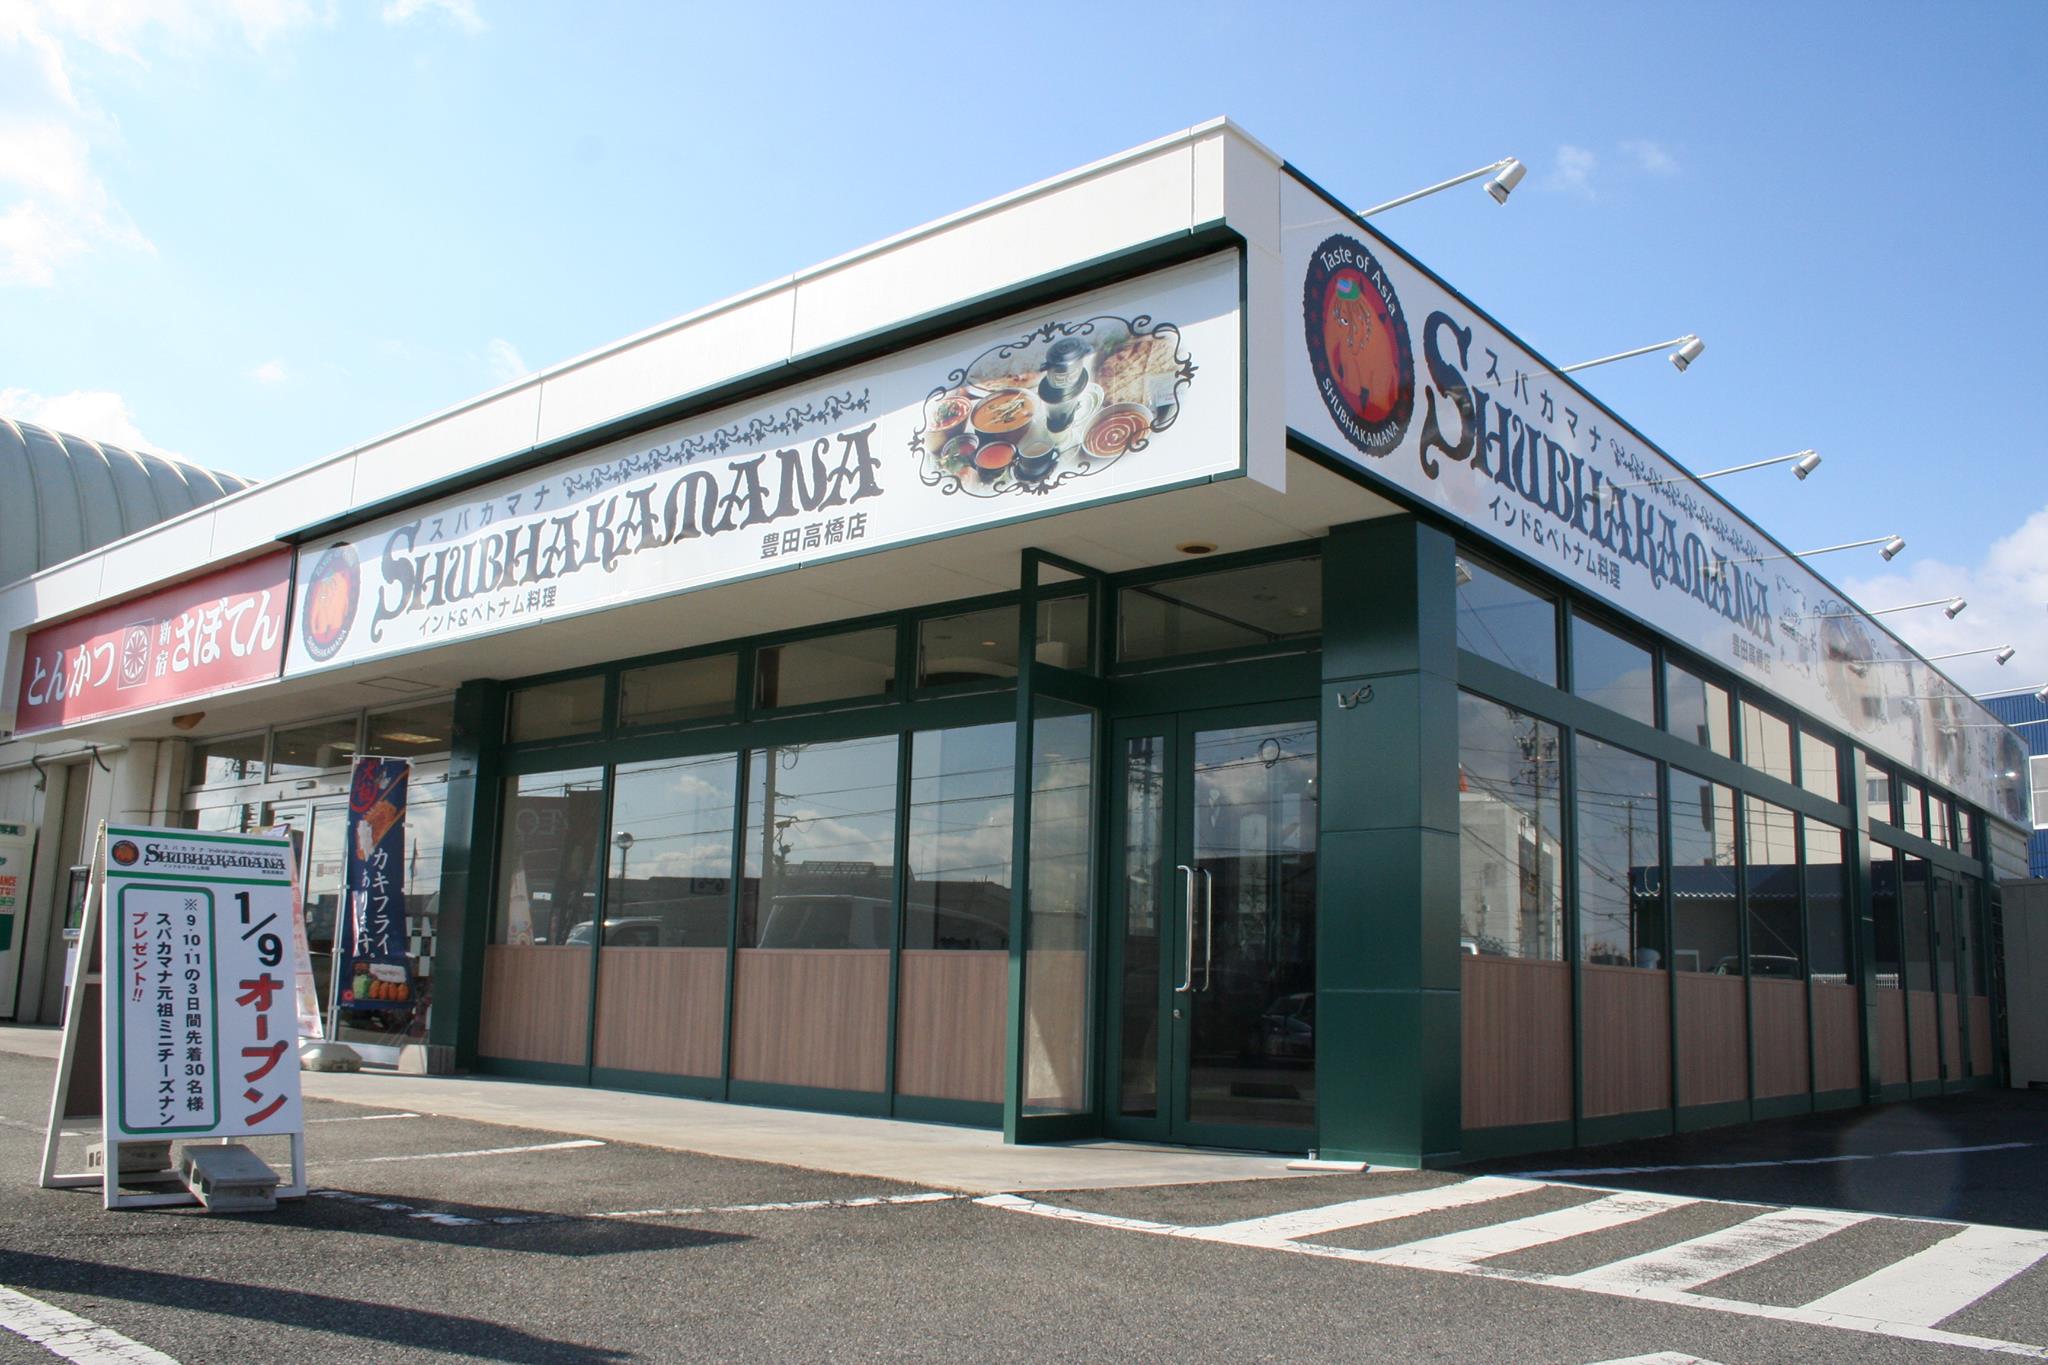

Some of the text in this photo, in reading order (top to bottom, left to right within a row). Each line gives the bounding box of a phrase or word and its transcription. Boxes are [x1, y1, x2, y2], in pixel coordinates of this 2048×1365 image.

[1320, 244, 1397, 318] Taste of Asia
[1322, 377, 1399, 448] SHUBHAKAMANA
[1485, 347, 1602, 453] スバカマナ
[429, 484, 550, 542] スバカマナ
[1419, 310, 1775, 648] SHUBHAKAMANA
[370, 422, 885, 643] SHUBHAKAMANA
[760, 512, 868, 560] 豊田高橋店
[1488, 495, 1621, 591] インド&ベトナム料理
[155, 618, 171, 678] 新宿
[172, 590, 281, 673] さぼてん
[418, 585, 557, 637] インド&ベトナム料理
[27, 641, 115, 706] とんかつ
[144, 843, 287, 870] SHUBHAKAMANA
[234, 891, 284, 967] 1/9
[372, 847, 391, 956] カキフライ
[235, 973, 289, 1127] オープン
